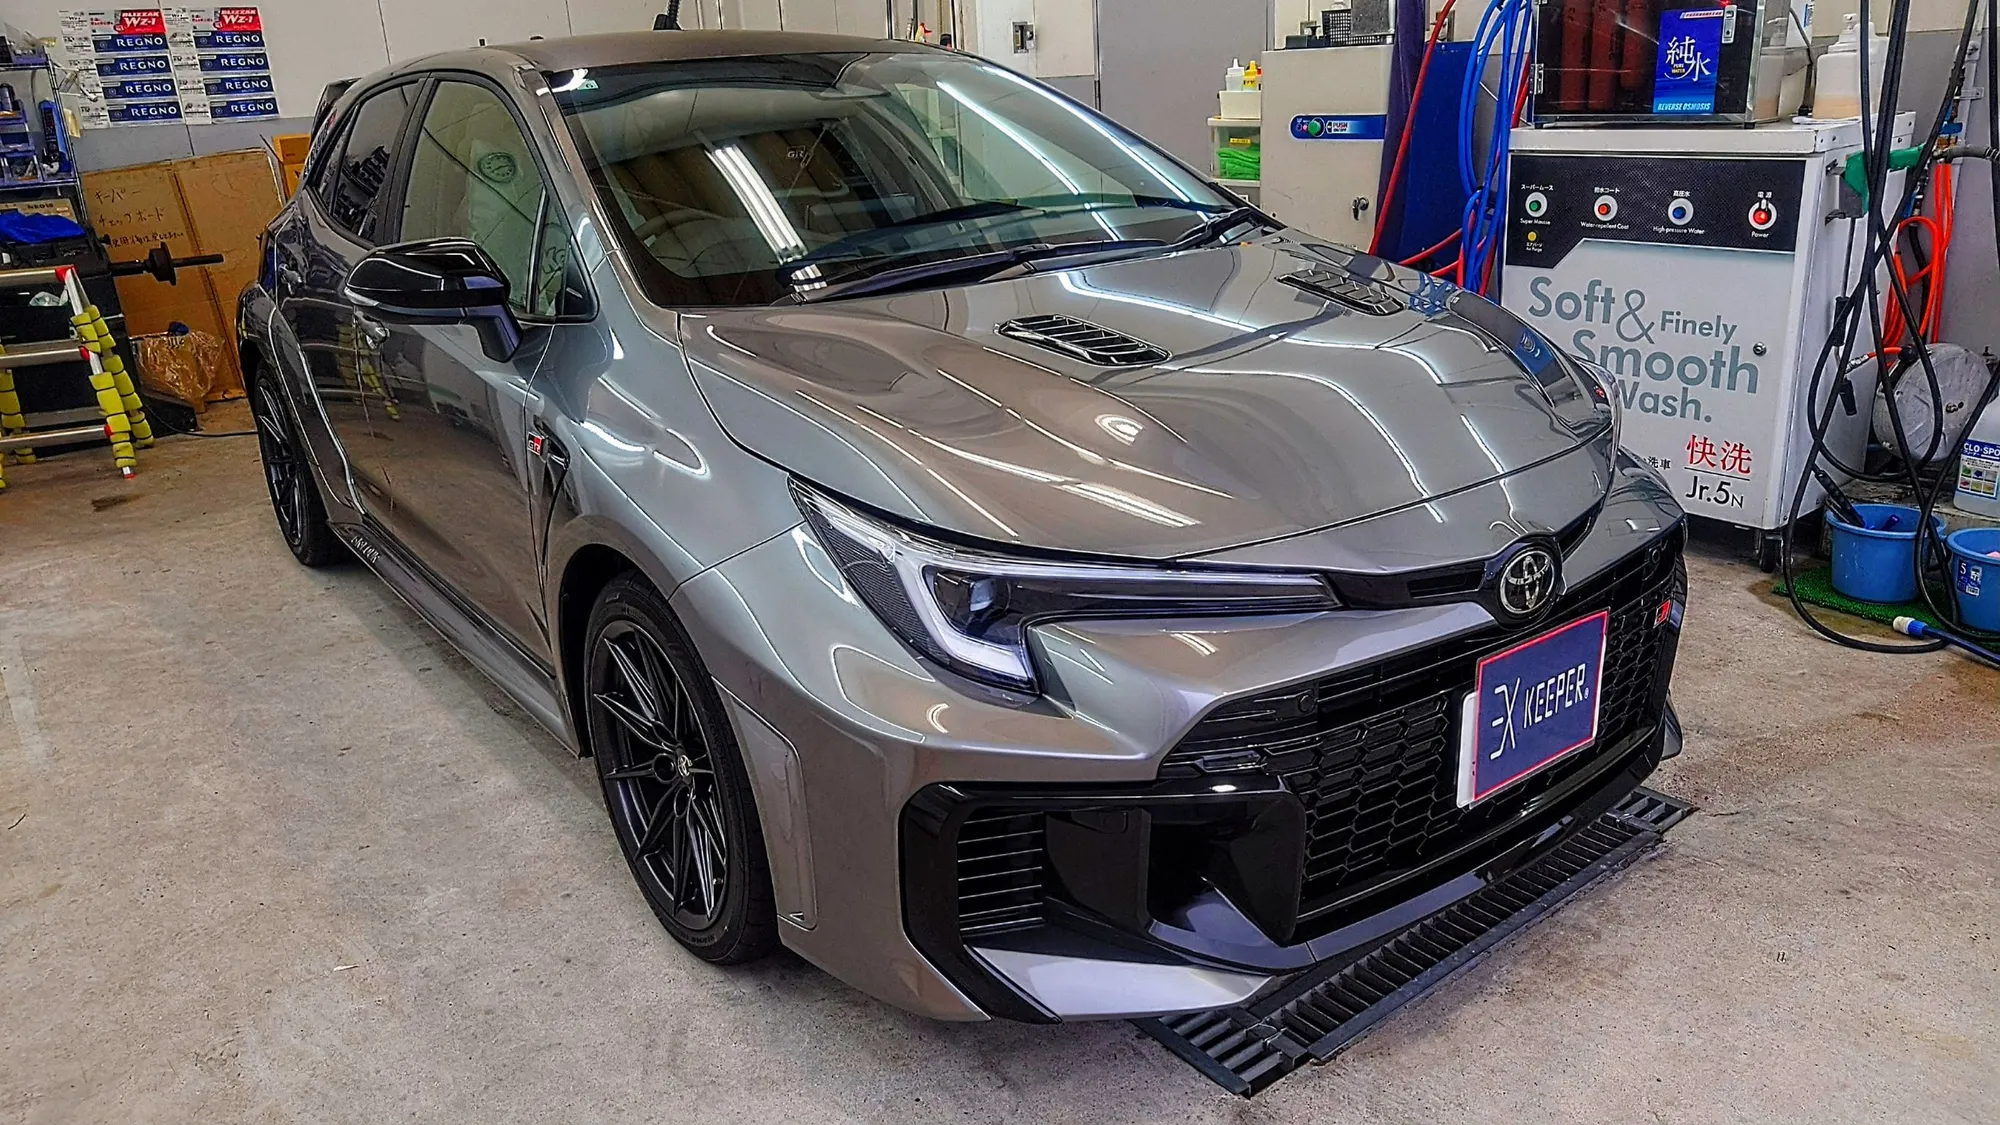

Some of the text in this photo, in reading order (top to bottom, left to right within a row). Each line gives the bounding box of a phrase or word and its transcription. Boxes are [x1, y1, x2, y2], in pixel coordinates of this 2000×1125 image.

[116, 37, 163, 47] REGNO
[216, 35, 260, 43] REGNO
[221, 58, 265, 66] REGNO
[1664, 36, 1711, 81] 純水
[120, 60, 166, 70] REGNO
[125, 83, 172, 93] REGNO
[225, 80, 269, 90] REGNO
[131, 106, 177, 116] REGNO
[230, 102, 274, 112] REGNO
[95, 188, 141, 204] キーパー
[1528, 276, 1737, 345] Soft & Finely
[1572, 329, 1759, 394] Smooth
[528, 440, 541, 453] GR
[1686, 434, 1752, 474] 快洗
[1523, 663, 1586, 729] KEEPER
